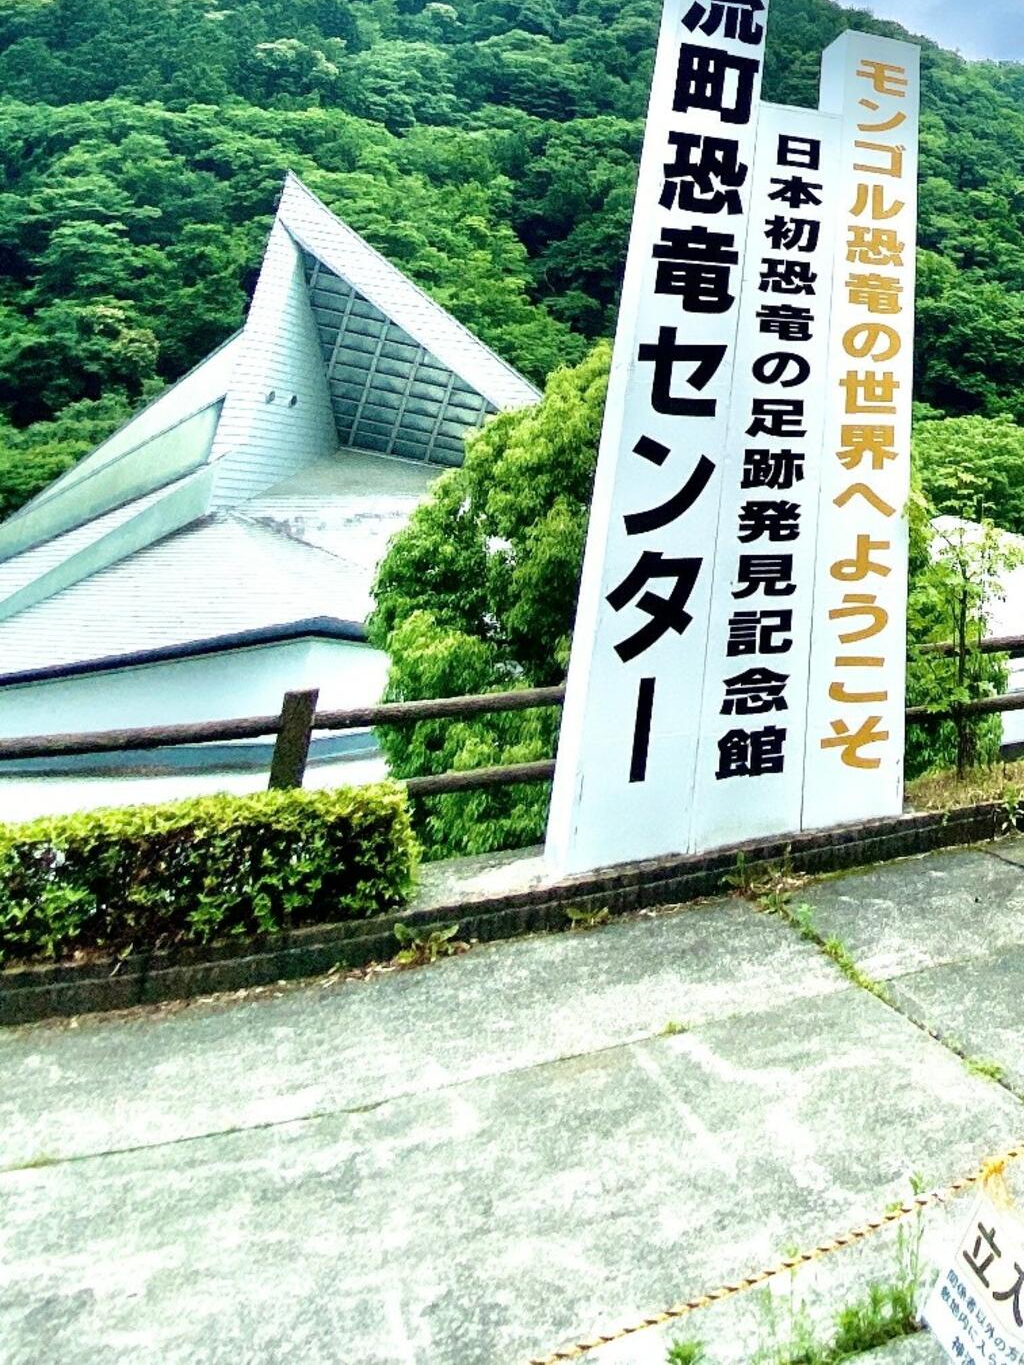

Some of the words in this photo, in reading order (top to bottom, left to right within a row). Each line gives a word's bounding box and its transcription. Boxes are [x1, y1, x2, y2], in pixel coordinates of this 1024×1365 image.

[715, 134, 824, 780] 日本初恐竜の足跡発見記念館
[820, 58, 908, 769] モンゴル恐竜の世界へようこそ
